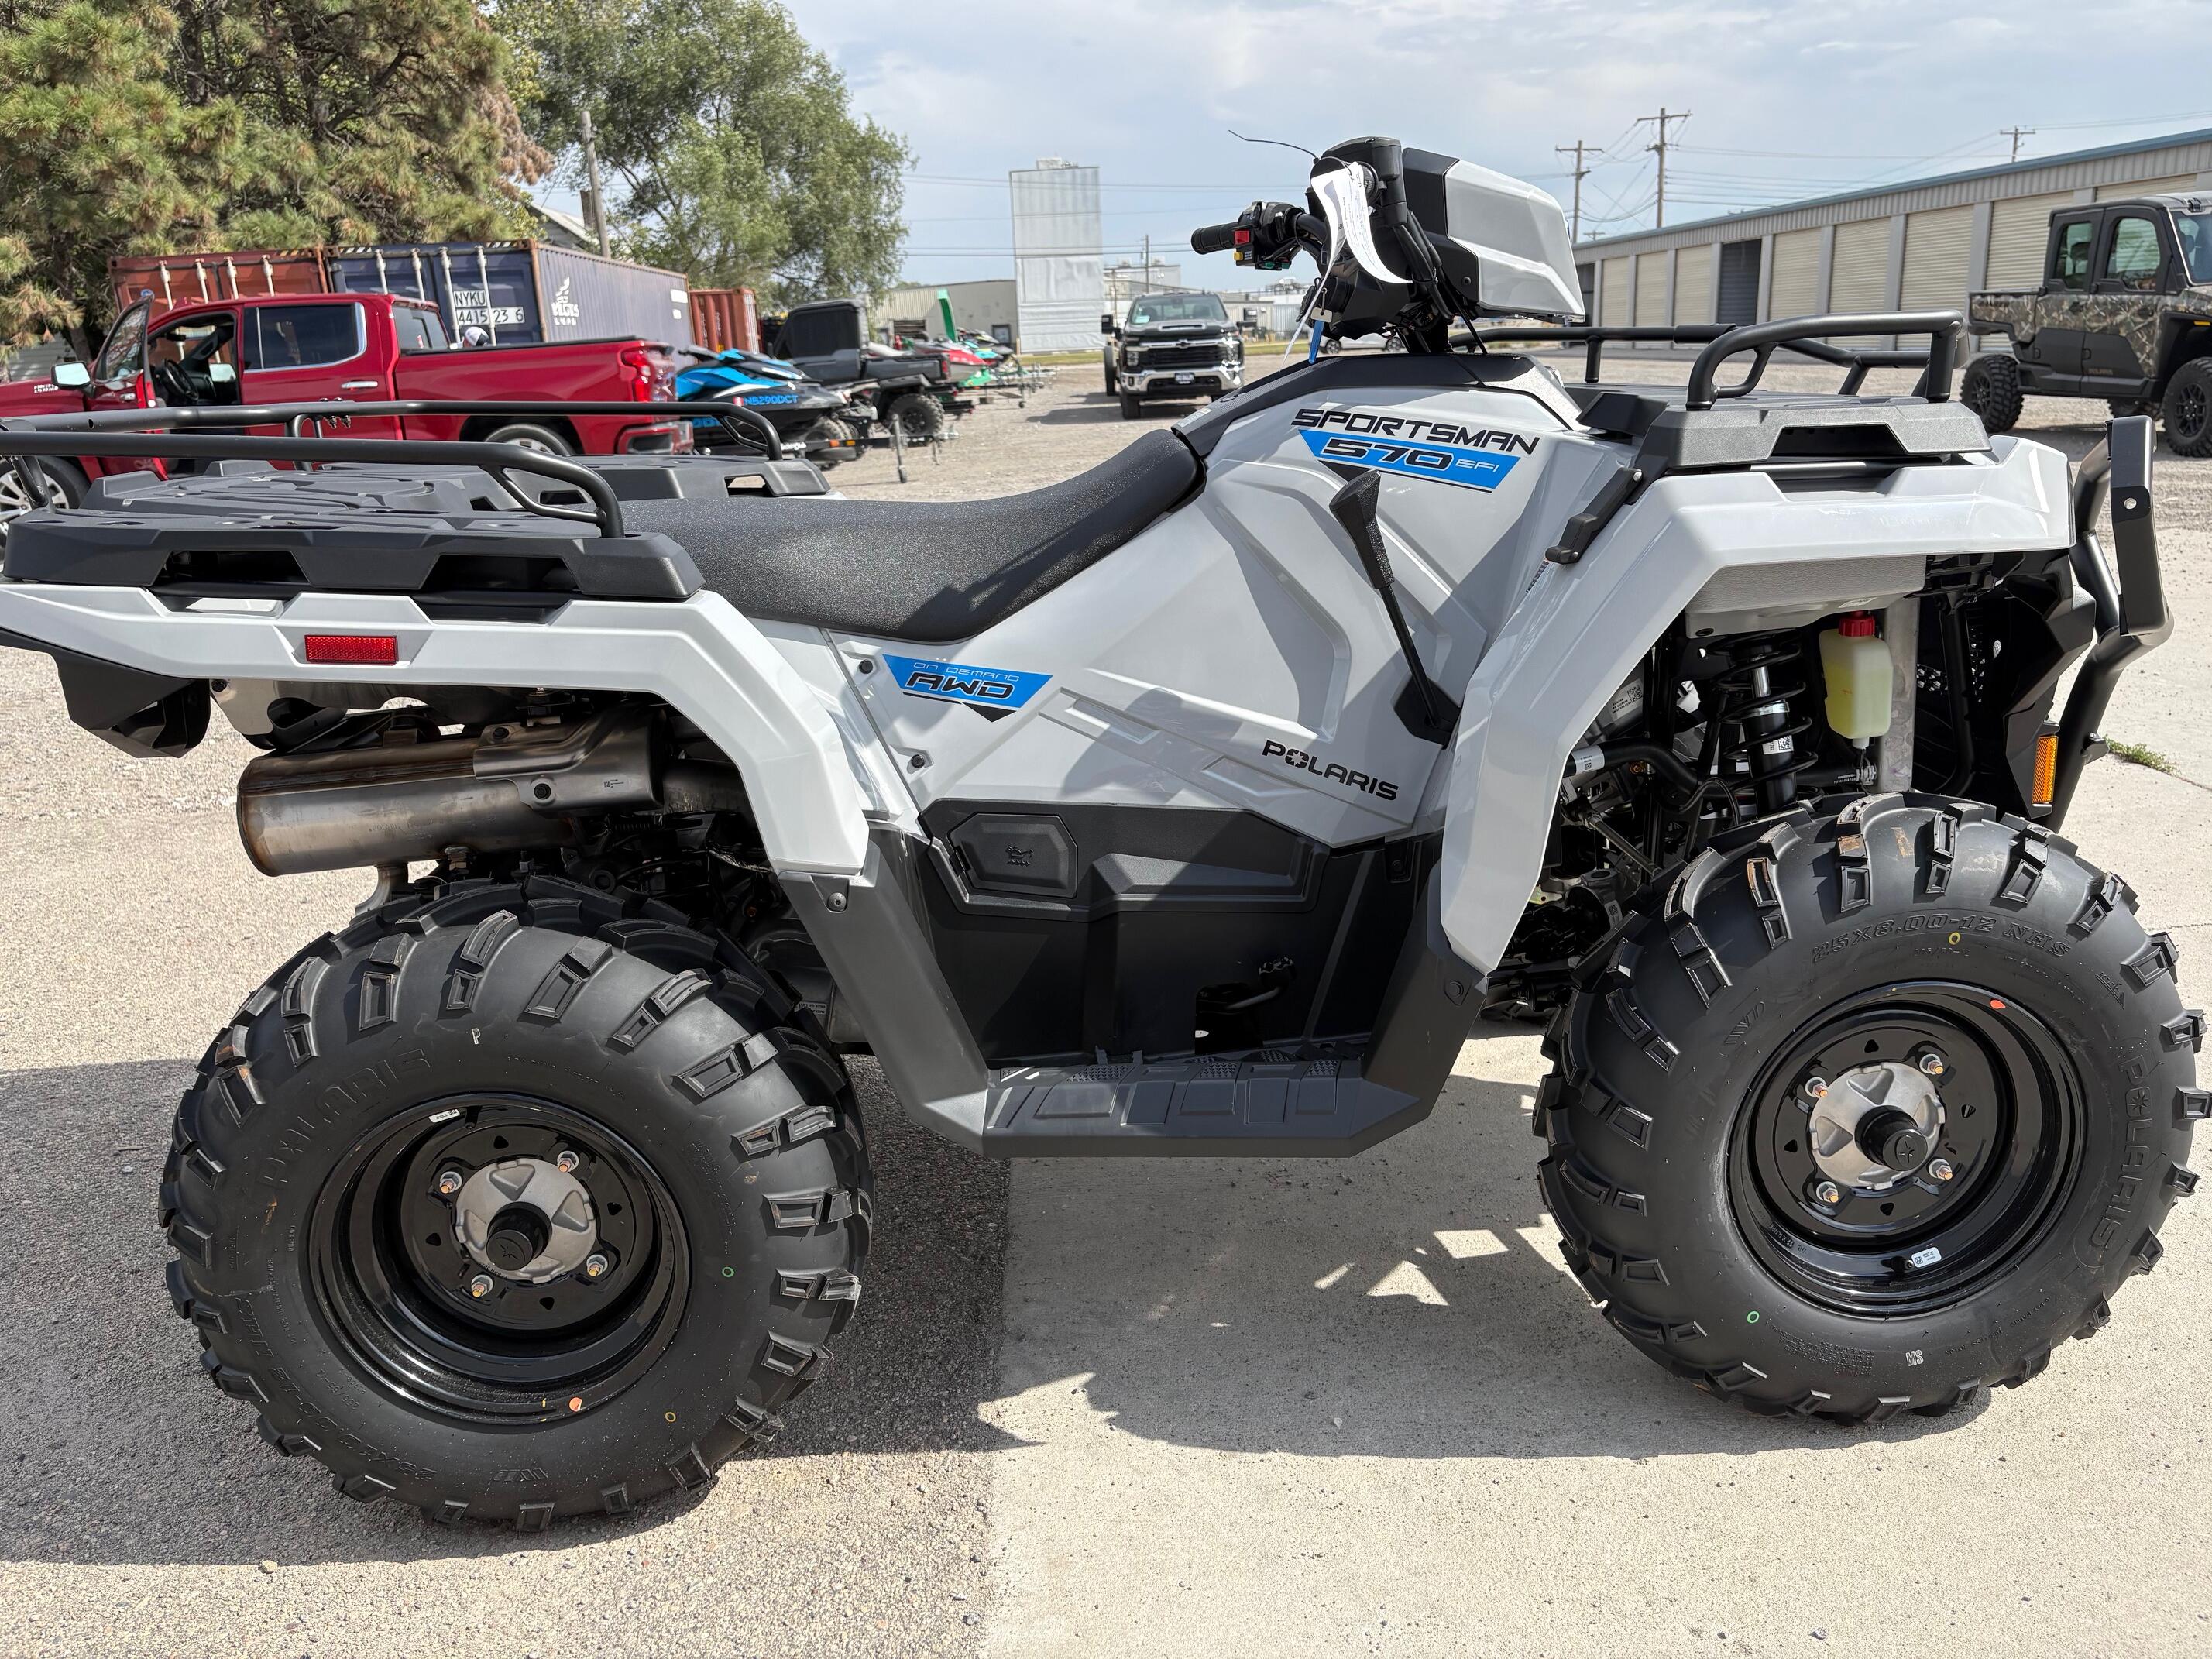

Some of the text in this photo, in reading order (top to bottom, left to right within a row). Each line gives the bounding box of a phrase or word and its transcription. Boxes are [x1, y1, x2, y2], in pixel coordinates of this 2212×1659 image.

[455, 291, 486, 306] NYKU
[516, 309, 524, 322] 6
[1291, 408, 1540, 455] SPORTSMAN
[1320, 437, 1499, 472] 570 EFI
[905, 672, 1015, 699] AWD
[913, 662, 1020, 682] ON DEMAND
[1262, 740, 1399, 801] POLARIS
[1811, 912, 2073, 963] 25X8.00-12 NHS
[2089, 1054, 2152, 1250] POLARIS
